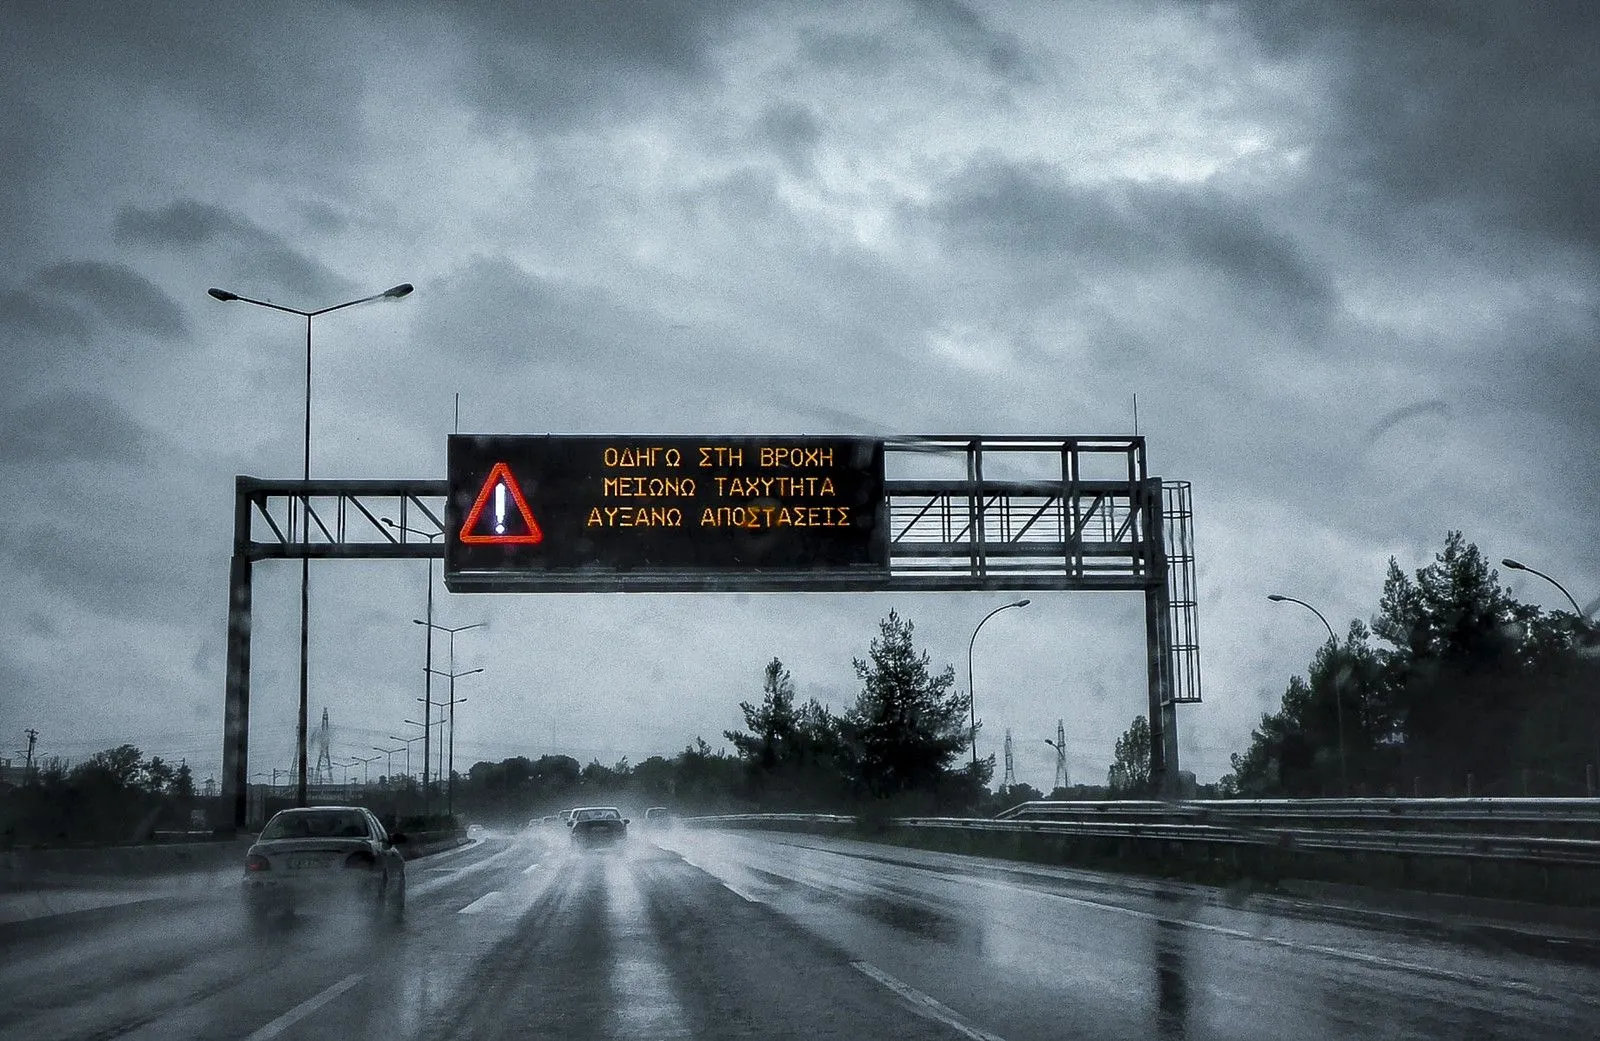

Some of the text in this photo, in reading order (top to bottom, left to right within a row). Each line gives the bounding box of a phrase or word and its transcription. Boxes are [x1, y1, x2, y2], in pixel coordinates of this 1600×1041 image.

[604, 447, 833, 467] ΟΔΗΓΩ ΣΤΗ ΒΡΟΧΗ
[604, 477, 836, 497] ΜΕΙΩΝΩ ΤΑΧΥΤΗΤΑ
[587, 507, 851, 528] ΑΥΞΑΝΩ ΑΠΟΣΤΑΣΕΙΣ
